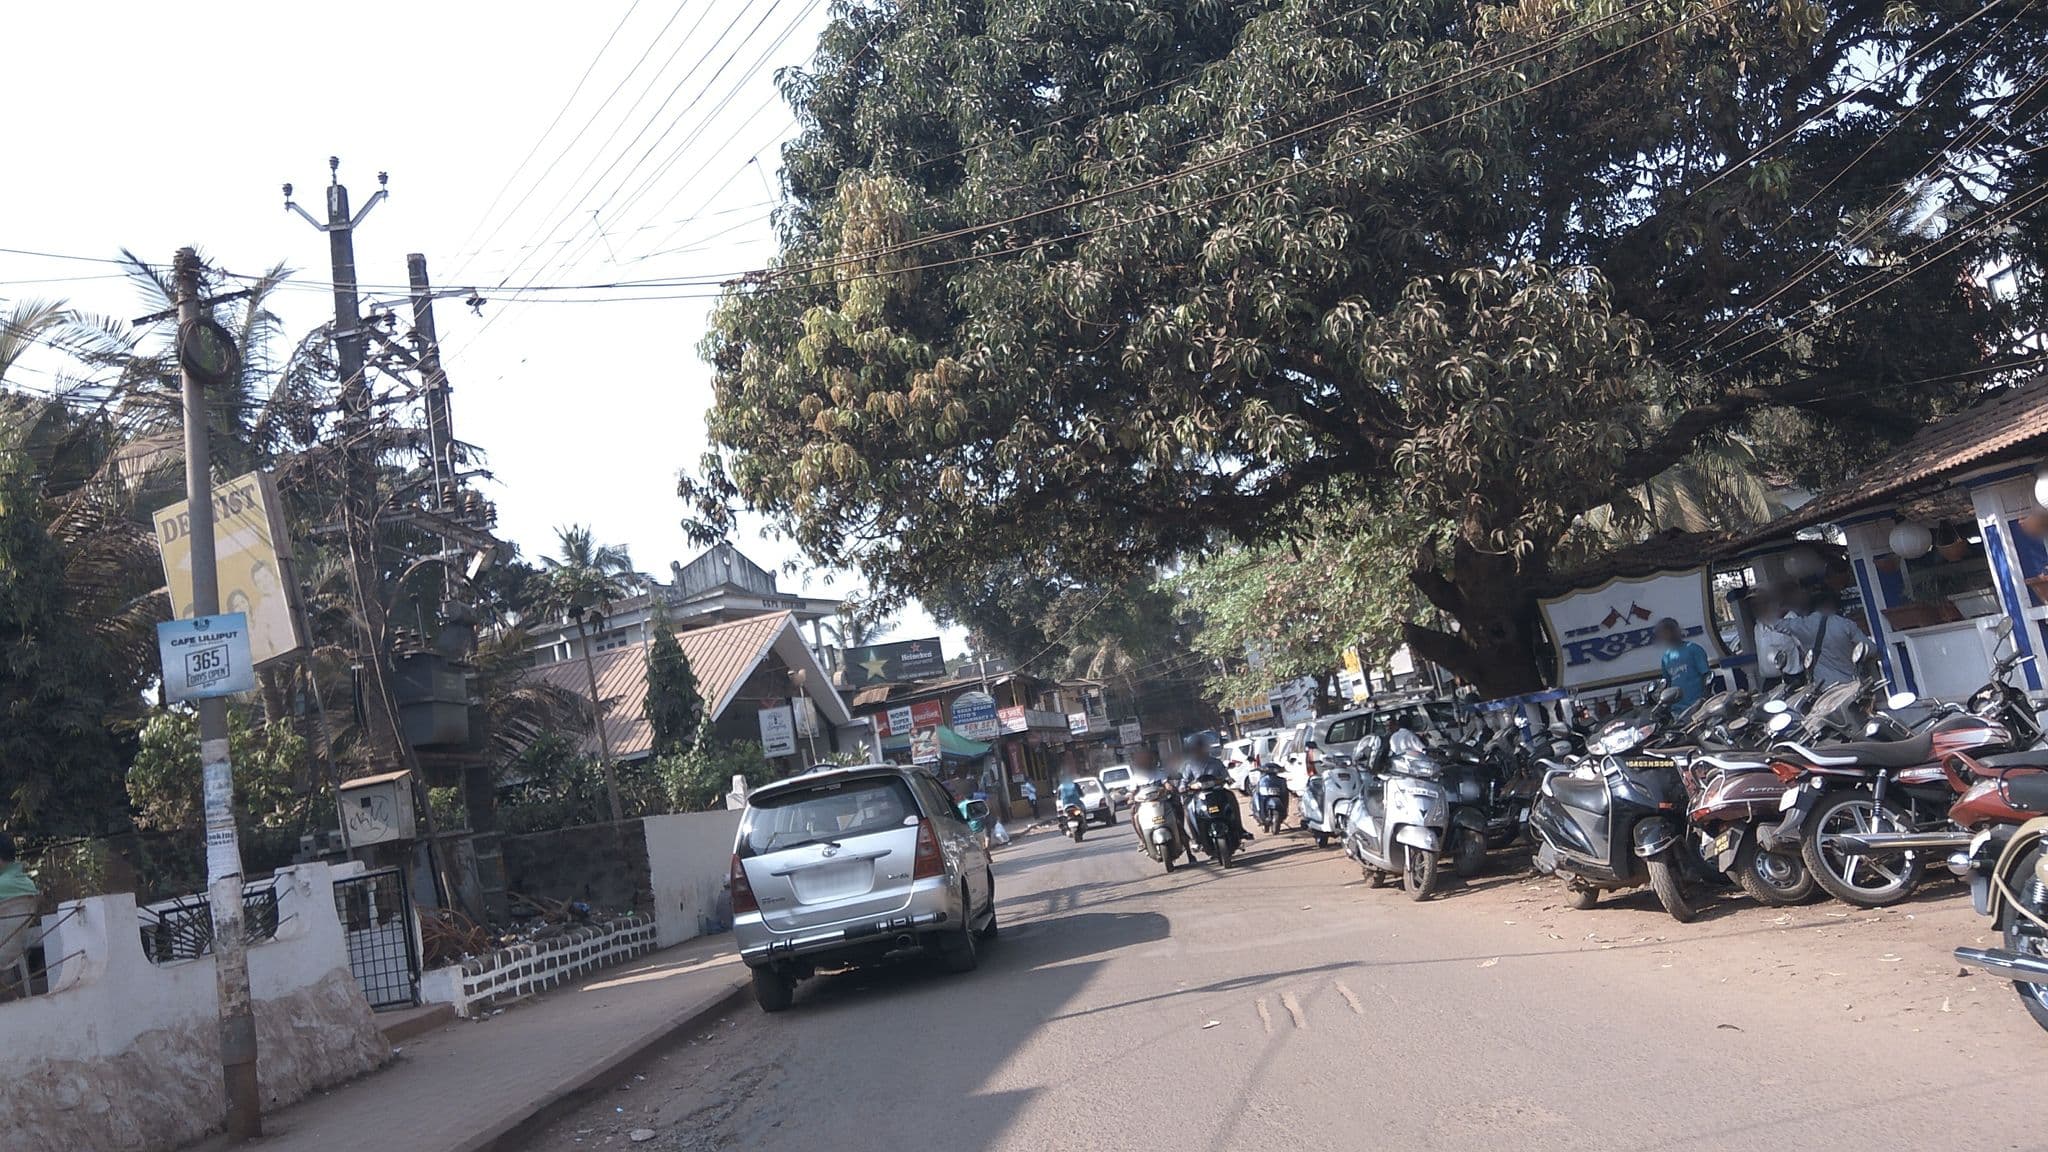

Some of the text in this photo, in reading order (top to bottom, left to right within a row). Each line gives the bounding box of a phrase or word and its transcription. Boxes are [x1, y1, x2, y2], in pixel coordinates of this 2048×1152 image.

[160, 484, 255, 545] DETIST
[170, 636, 196, 647] CAFE
[198, 631, 238, 642] LILLIPUT
[192, 649, 220, 672] 365
[208, 667, 226, 679] OPEN
